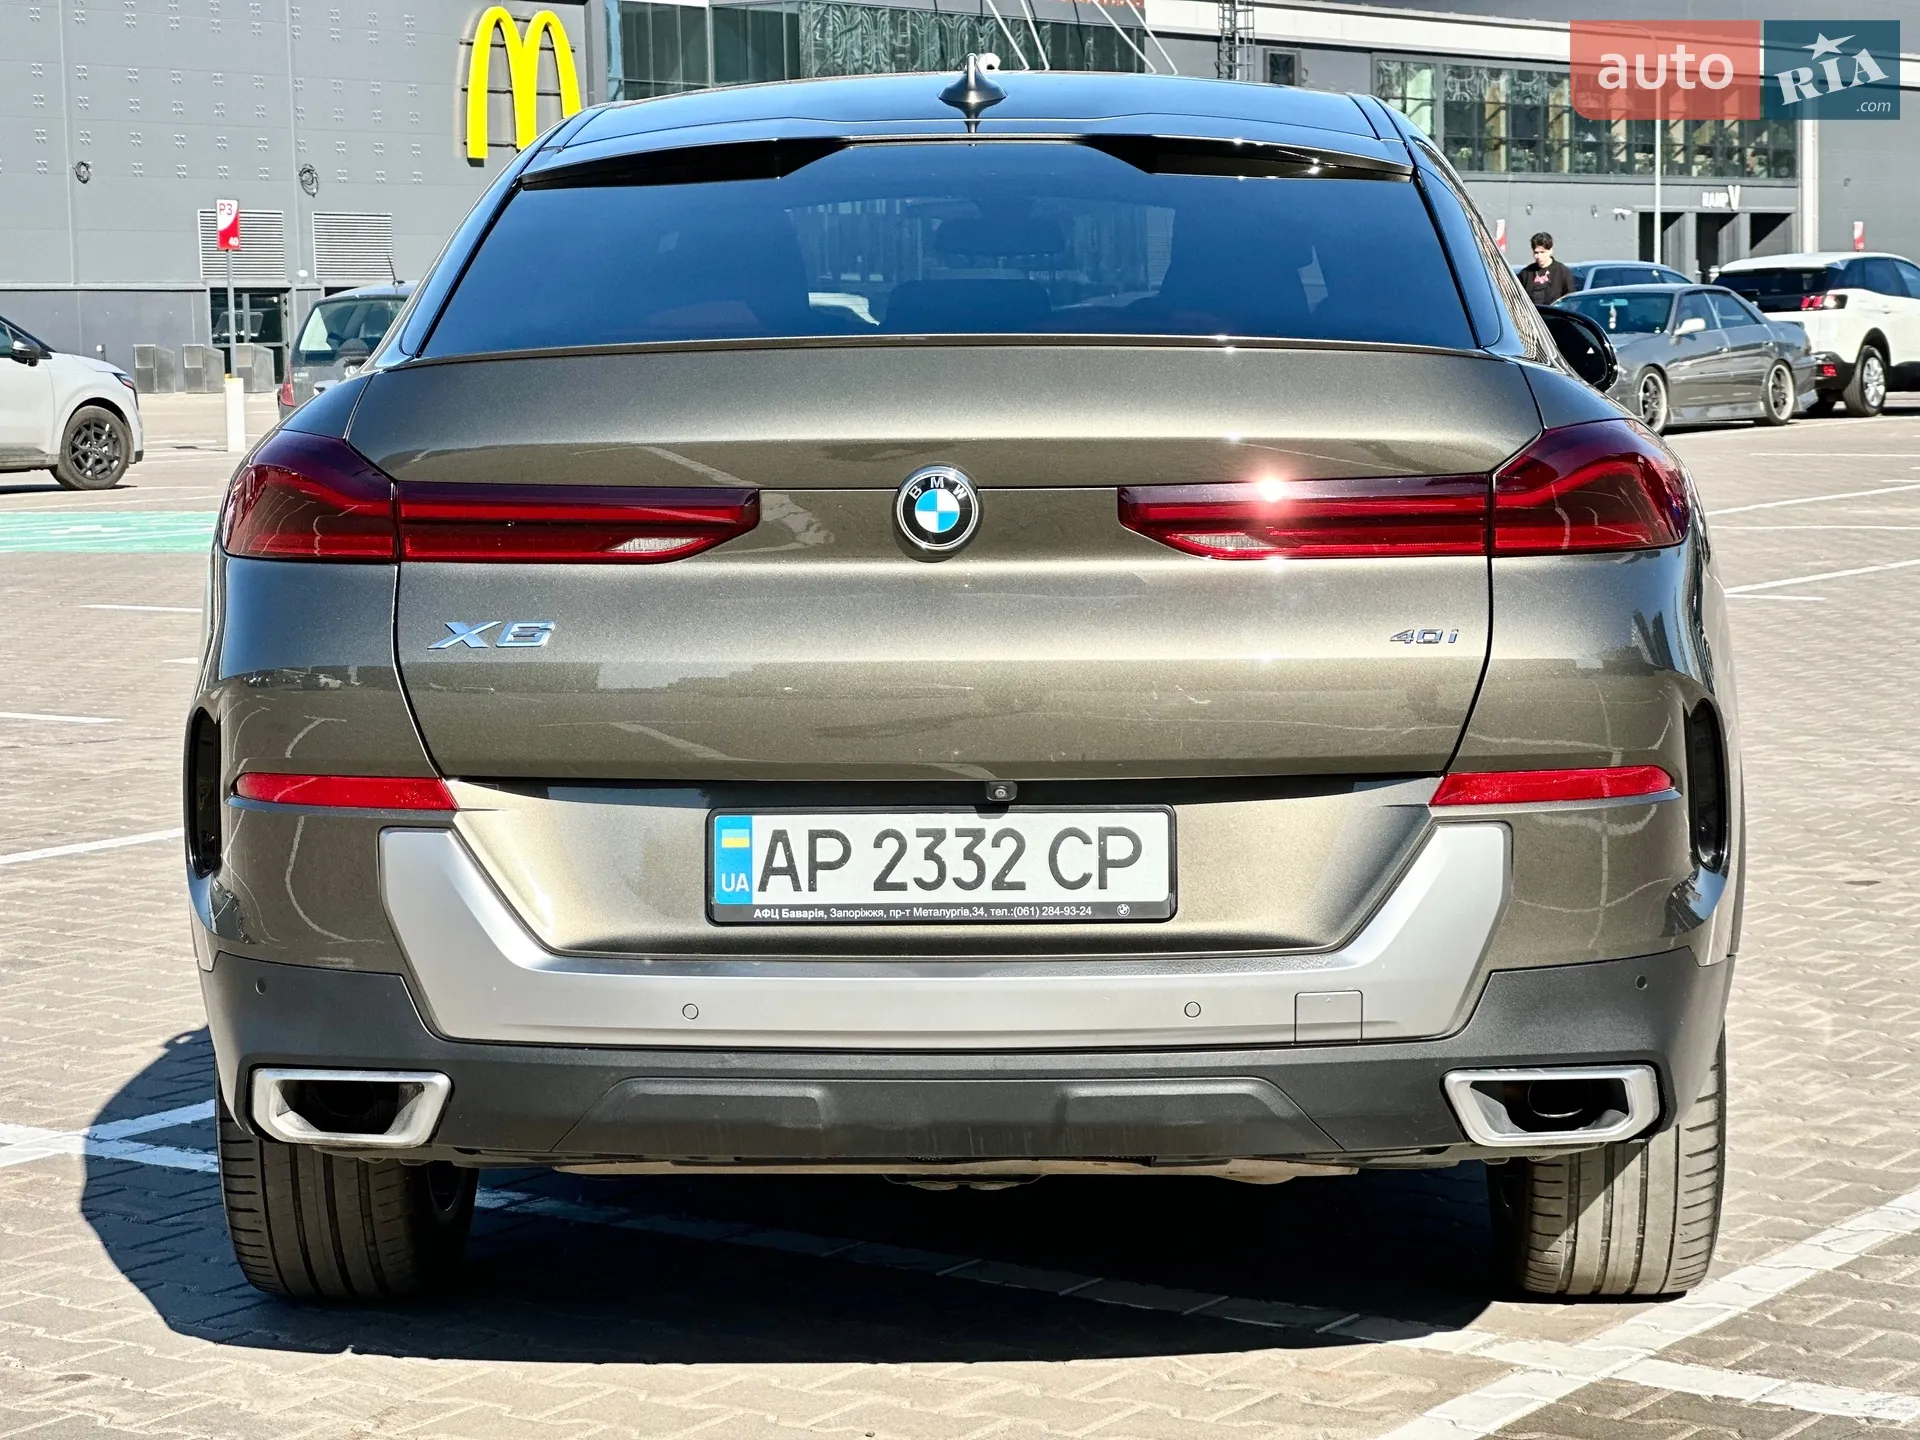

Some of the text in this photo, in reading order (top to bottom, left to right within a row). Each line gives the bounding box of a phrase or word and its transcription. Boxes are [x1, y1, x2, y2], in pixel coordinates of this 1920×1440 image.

[219, 203, 233, 215] P3
[908, 476, 968, 500] BMW
[427, 620, 556, 649] X6
[1390, 629, 1459, 644] 40i
[757, 826, 1143, 892] AP 2332 CP
[721, 872, 750, 893] UA
[753, 908, 779, 919] АФЦ
[781, 908, 827, 919] Баварія,
[830, 907, 887, 919] Запоріжжя,
[889, 907, 910, 919] пр-т
[1042, 906, 1092, 917] 284-93-24
